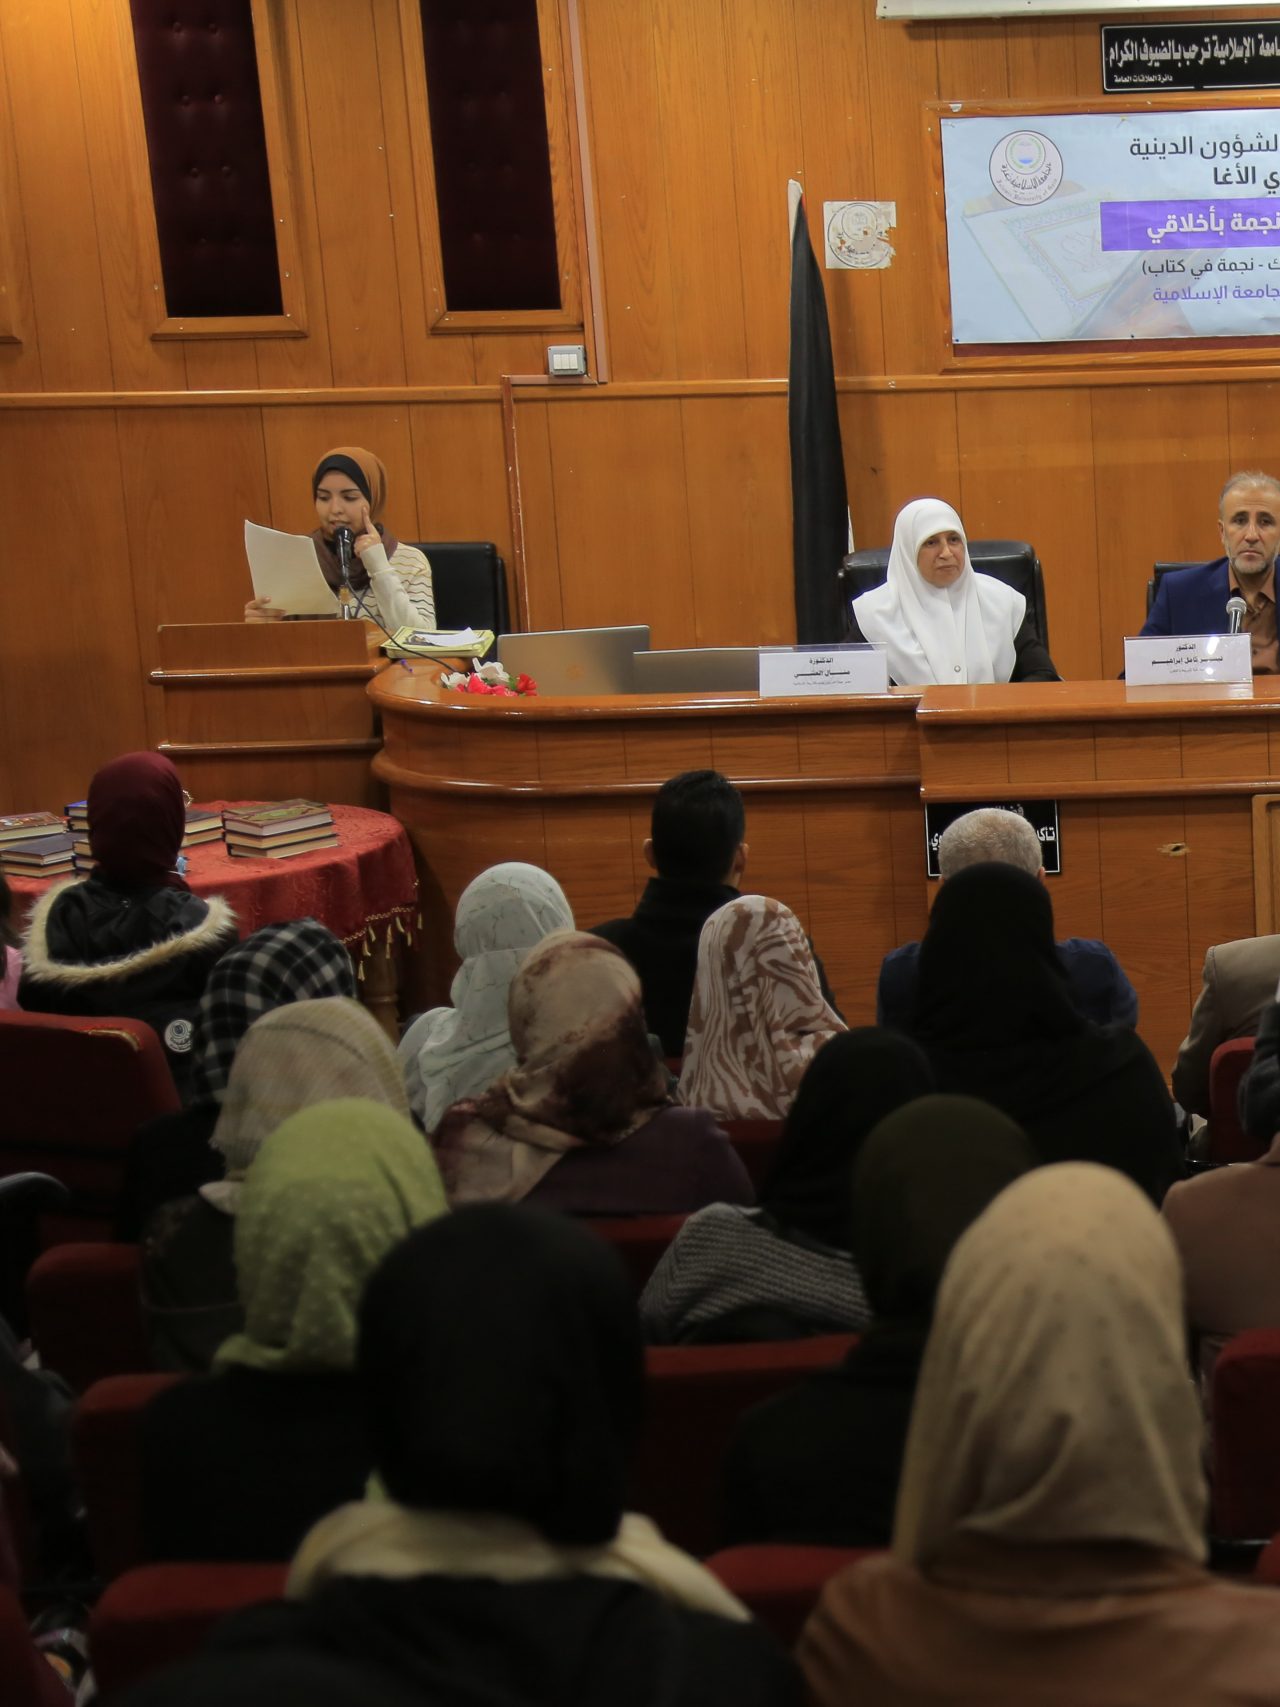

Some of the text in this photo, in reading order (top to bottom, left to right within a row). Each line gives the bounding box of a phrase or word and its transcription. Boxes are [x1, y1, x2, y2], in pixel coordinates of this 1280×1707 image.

[1109, 38, 1138, 68] الكرام
[1130, 136, 1193, 160] الدينية
[1213, 163, 1256, 185] الأغا
[1146, 206, 1225, 244] بأخلاقي
[1142, 259, 1186, 277] كتاب)
[1190, 258, 1213, 280] في
[1217, 257, 1254, 275] نجمة
[1153, 284, 1228, 305] الإسلامية
